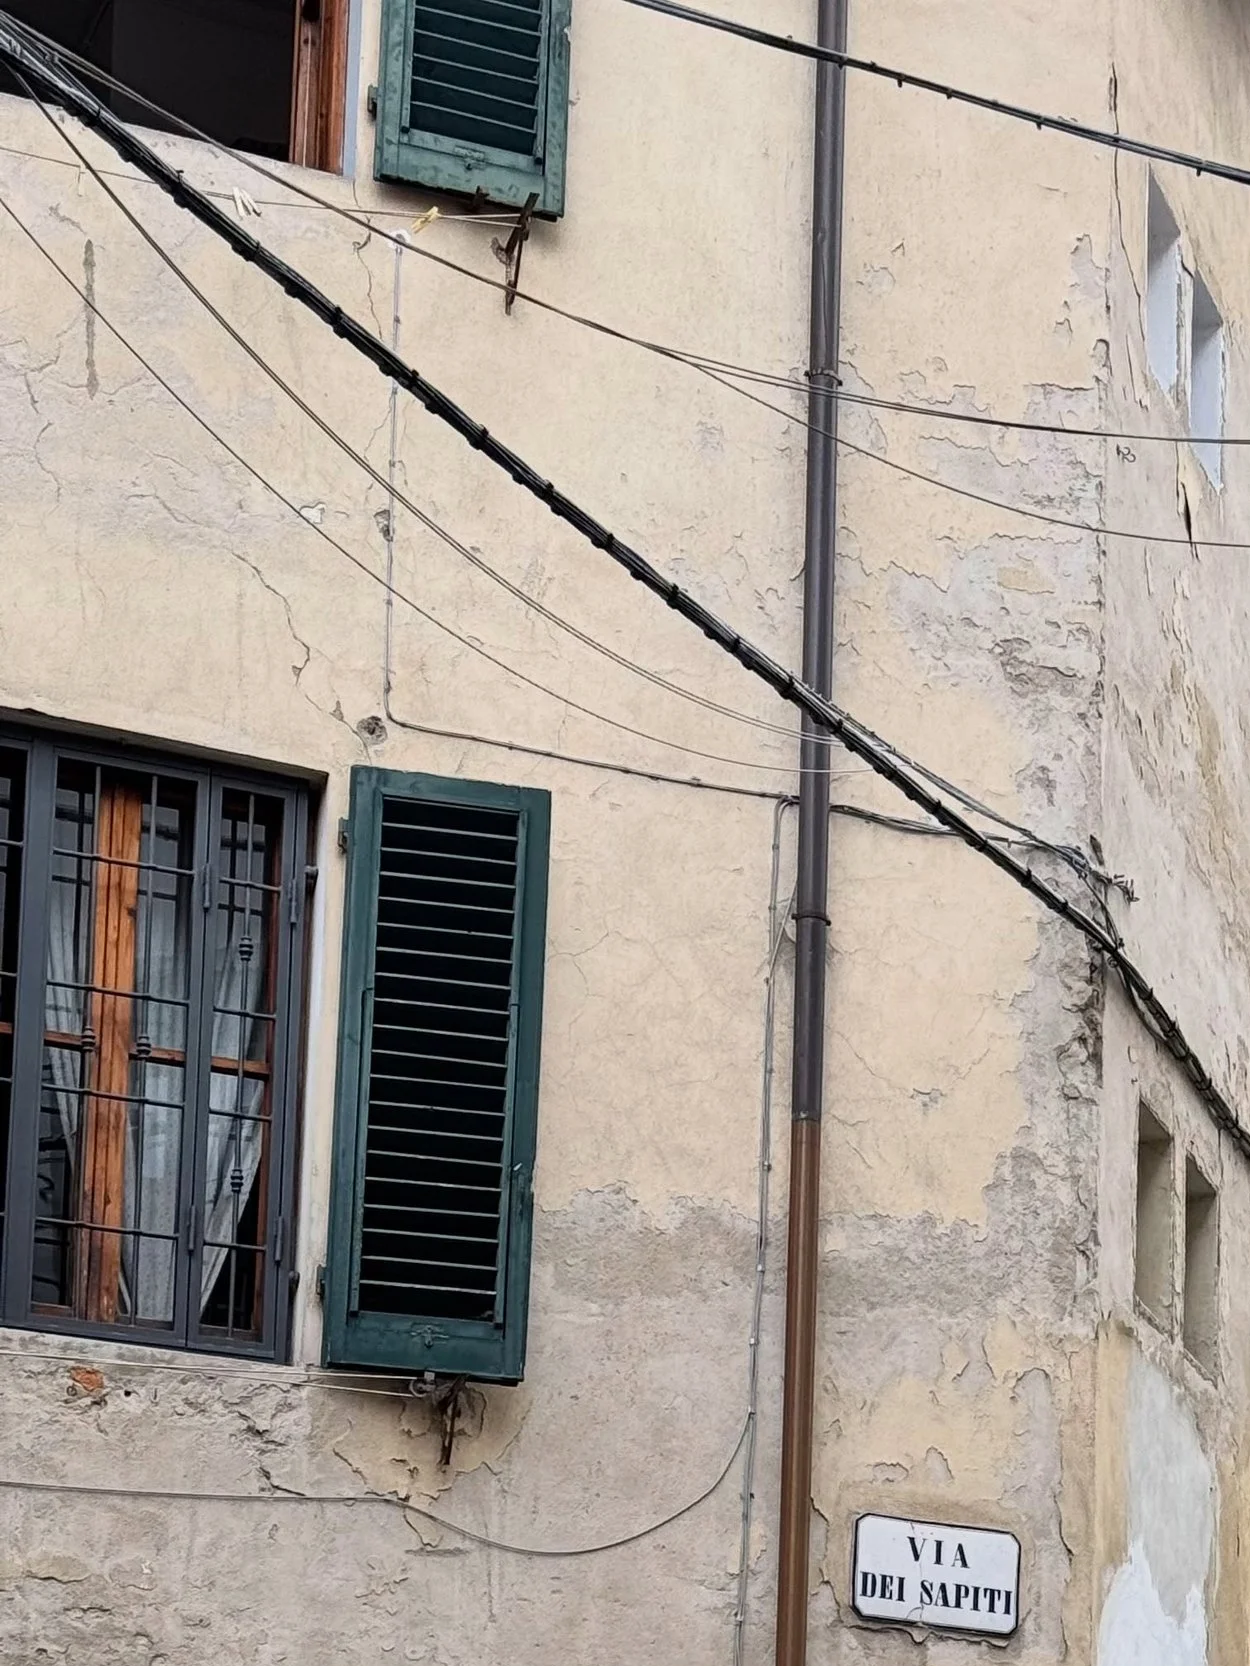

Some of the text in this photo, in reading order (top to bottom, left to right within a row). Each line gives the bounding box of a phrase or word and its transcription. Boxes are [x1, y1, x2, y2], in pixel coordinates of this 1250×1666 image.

[907, 1536, 970, 1569] VIA
[859, 1571, 1013, 1615] DEI SAPITI
